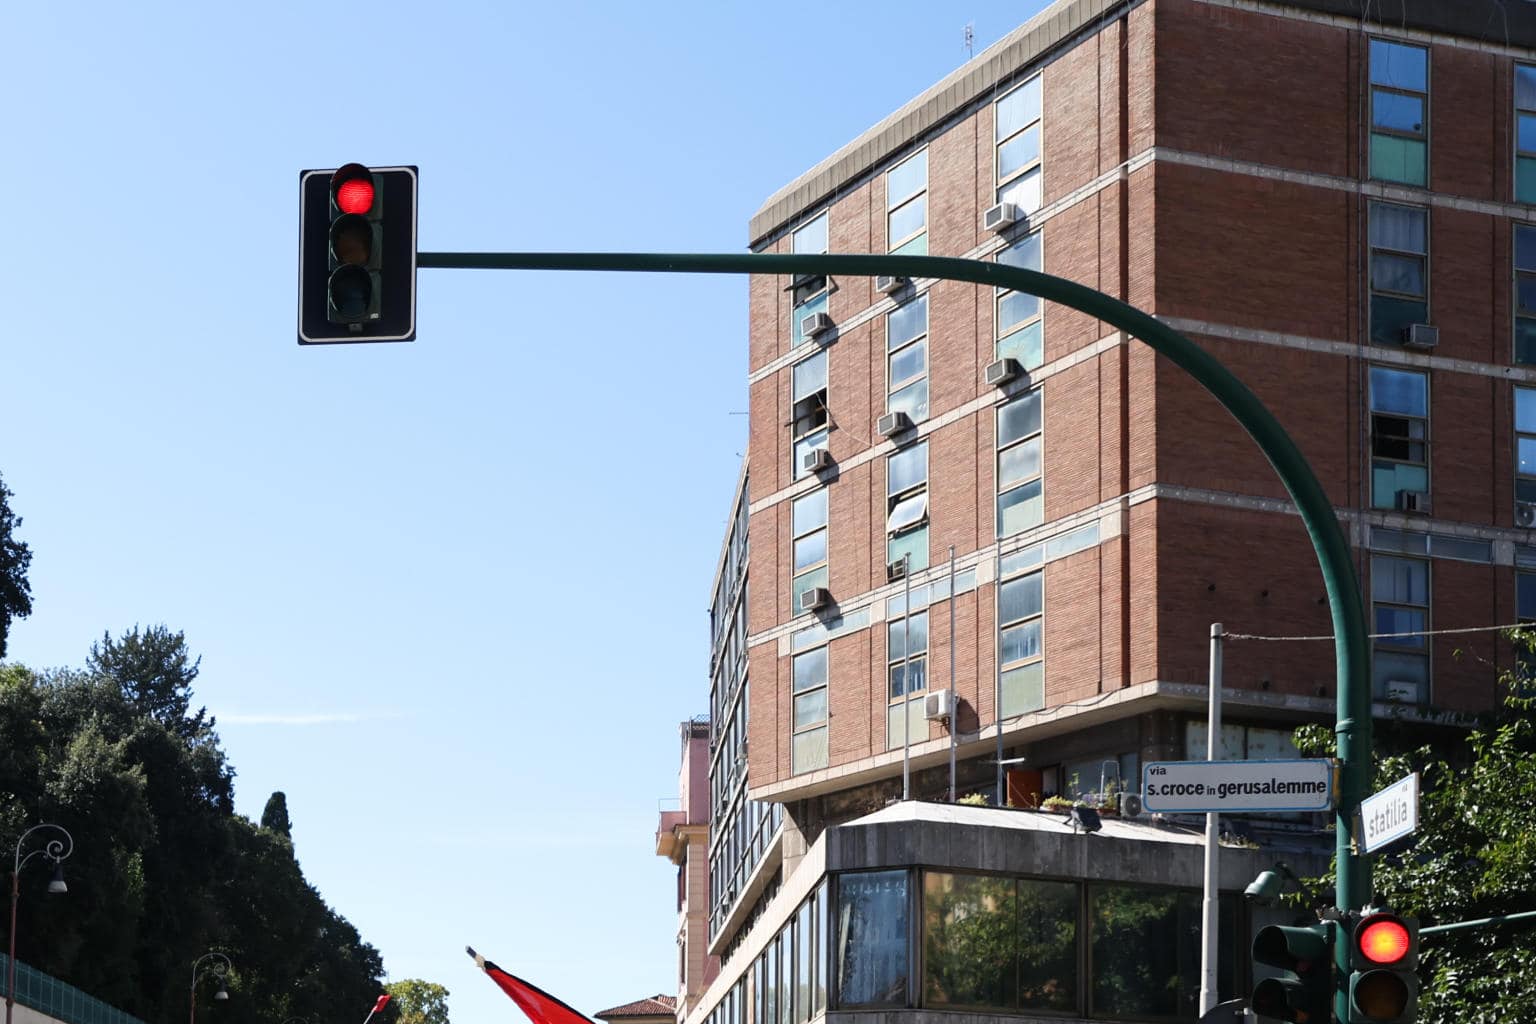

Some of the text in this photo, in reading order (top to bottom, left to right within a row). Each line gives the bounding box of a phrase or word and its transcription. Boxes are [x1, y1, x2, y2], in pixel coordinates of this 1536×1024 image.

[1149, 766, 1167, 776] via
[1147, 778, 1327, 799] s.croce in gerusalemme
[1369, 797, 1408, 838] statilia
